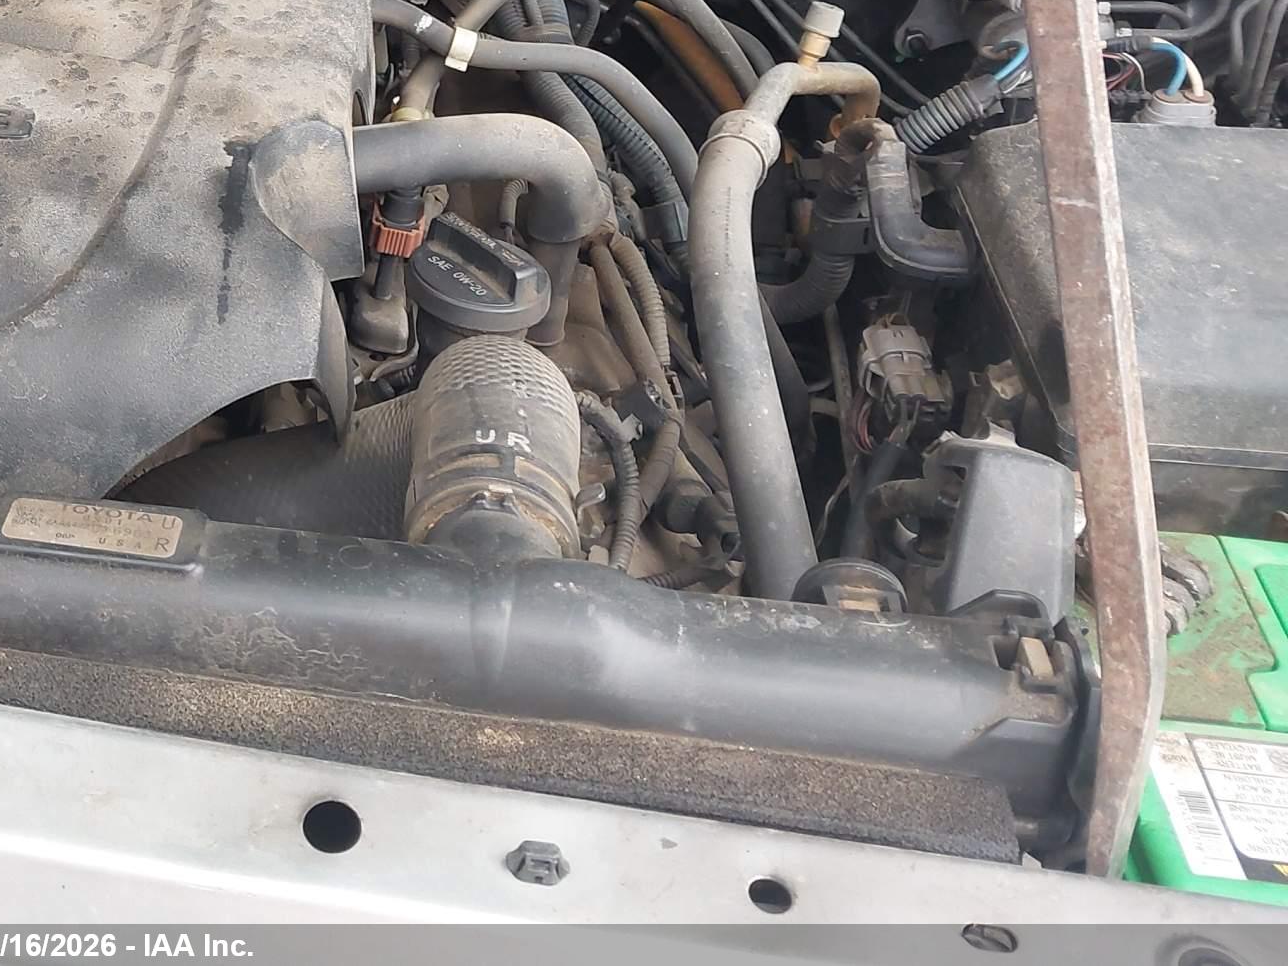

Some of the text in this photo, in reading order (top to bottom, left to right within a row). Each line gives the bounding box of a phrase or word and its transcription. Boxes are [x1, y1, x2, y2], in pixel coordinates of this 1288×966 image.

[428, 255, 487, 296] SAE 0W-20
[63, 504, 153, 523] TOYOTA
